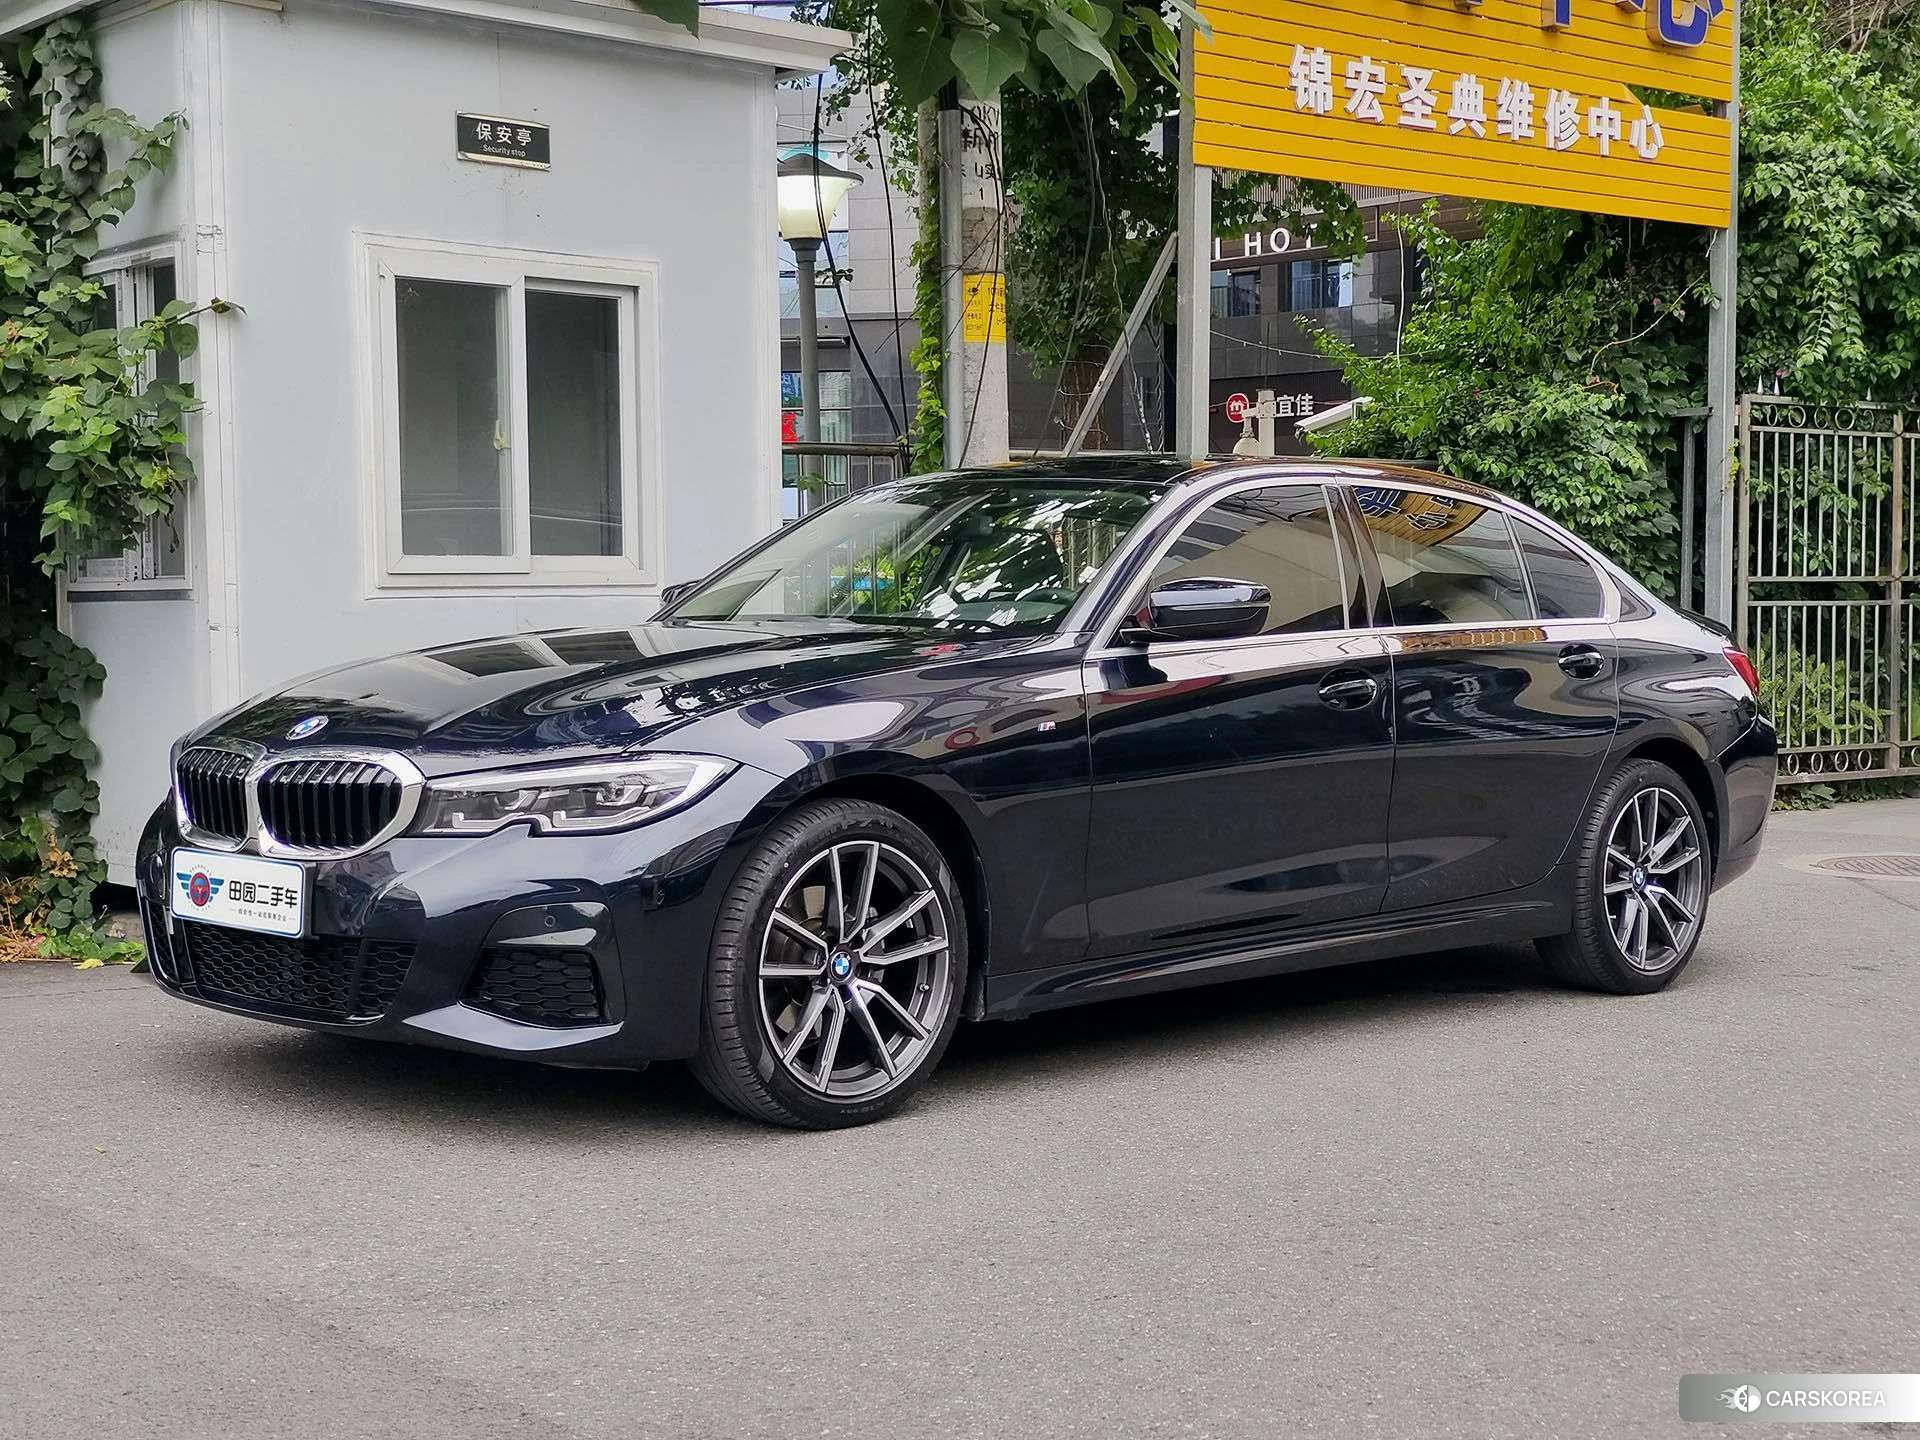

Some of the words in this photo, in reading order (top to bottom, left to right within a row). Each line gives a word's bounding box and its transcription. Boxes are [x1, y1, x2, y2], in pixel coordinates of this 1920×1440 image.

[1288, 44, 1664, 160] 锦宏圣典维修中心
[476, 121, 532, 146] 保安亭
[483, 145, 510, 156] Security
[511, 149, 527, 158] stop
[1275, 393, 1314, 417] 宜佳
[229, 880, 298, 908] 田园二手车
